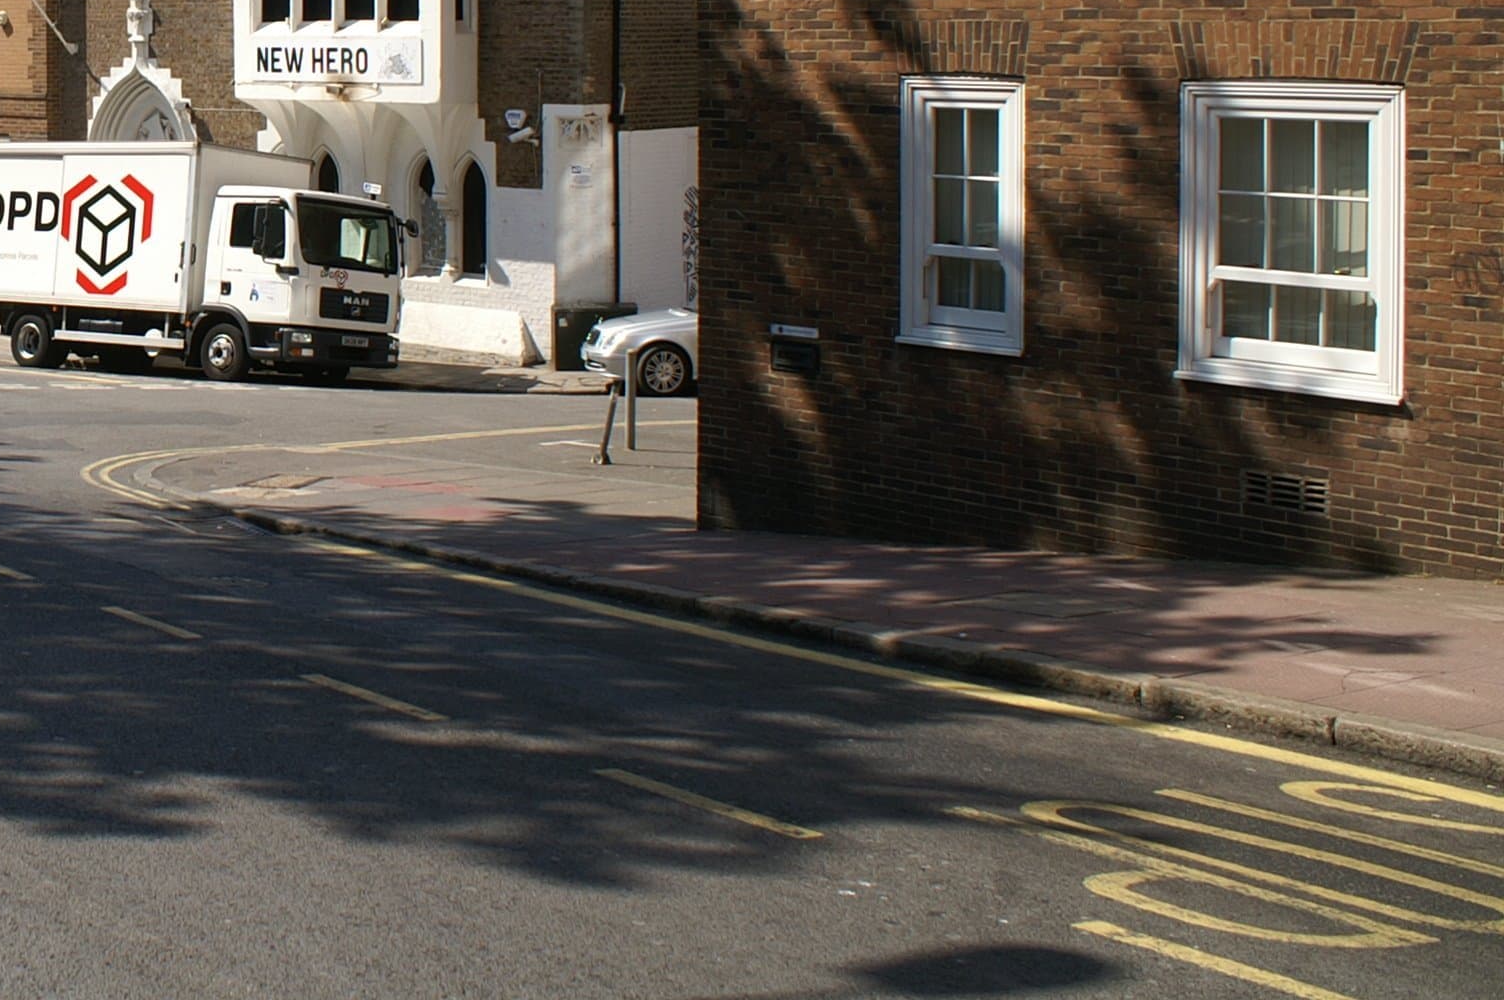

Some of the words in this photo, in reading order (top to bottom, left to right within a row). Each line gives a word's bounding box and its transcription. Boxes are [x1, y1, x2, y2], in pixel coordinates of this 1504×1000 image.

[256, 47, 304, 73] NEW
[311, 47, 369, 74] HERO
[343, 295, 369, 306] MAN
